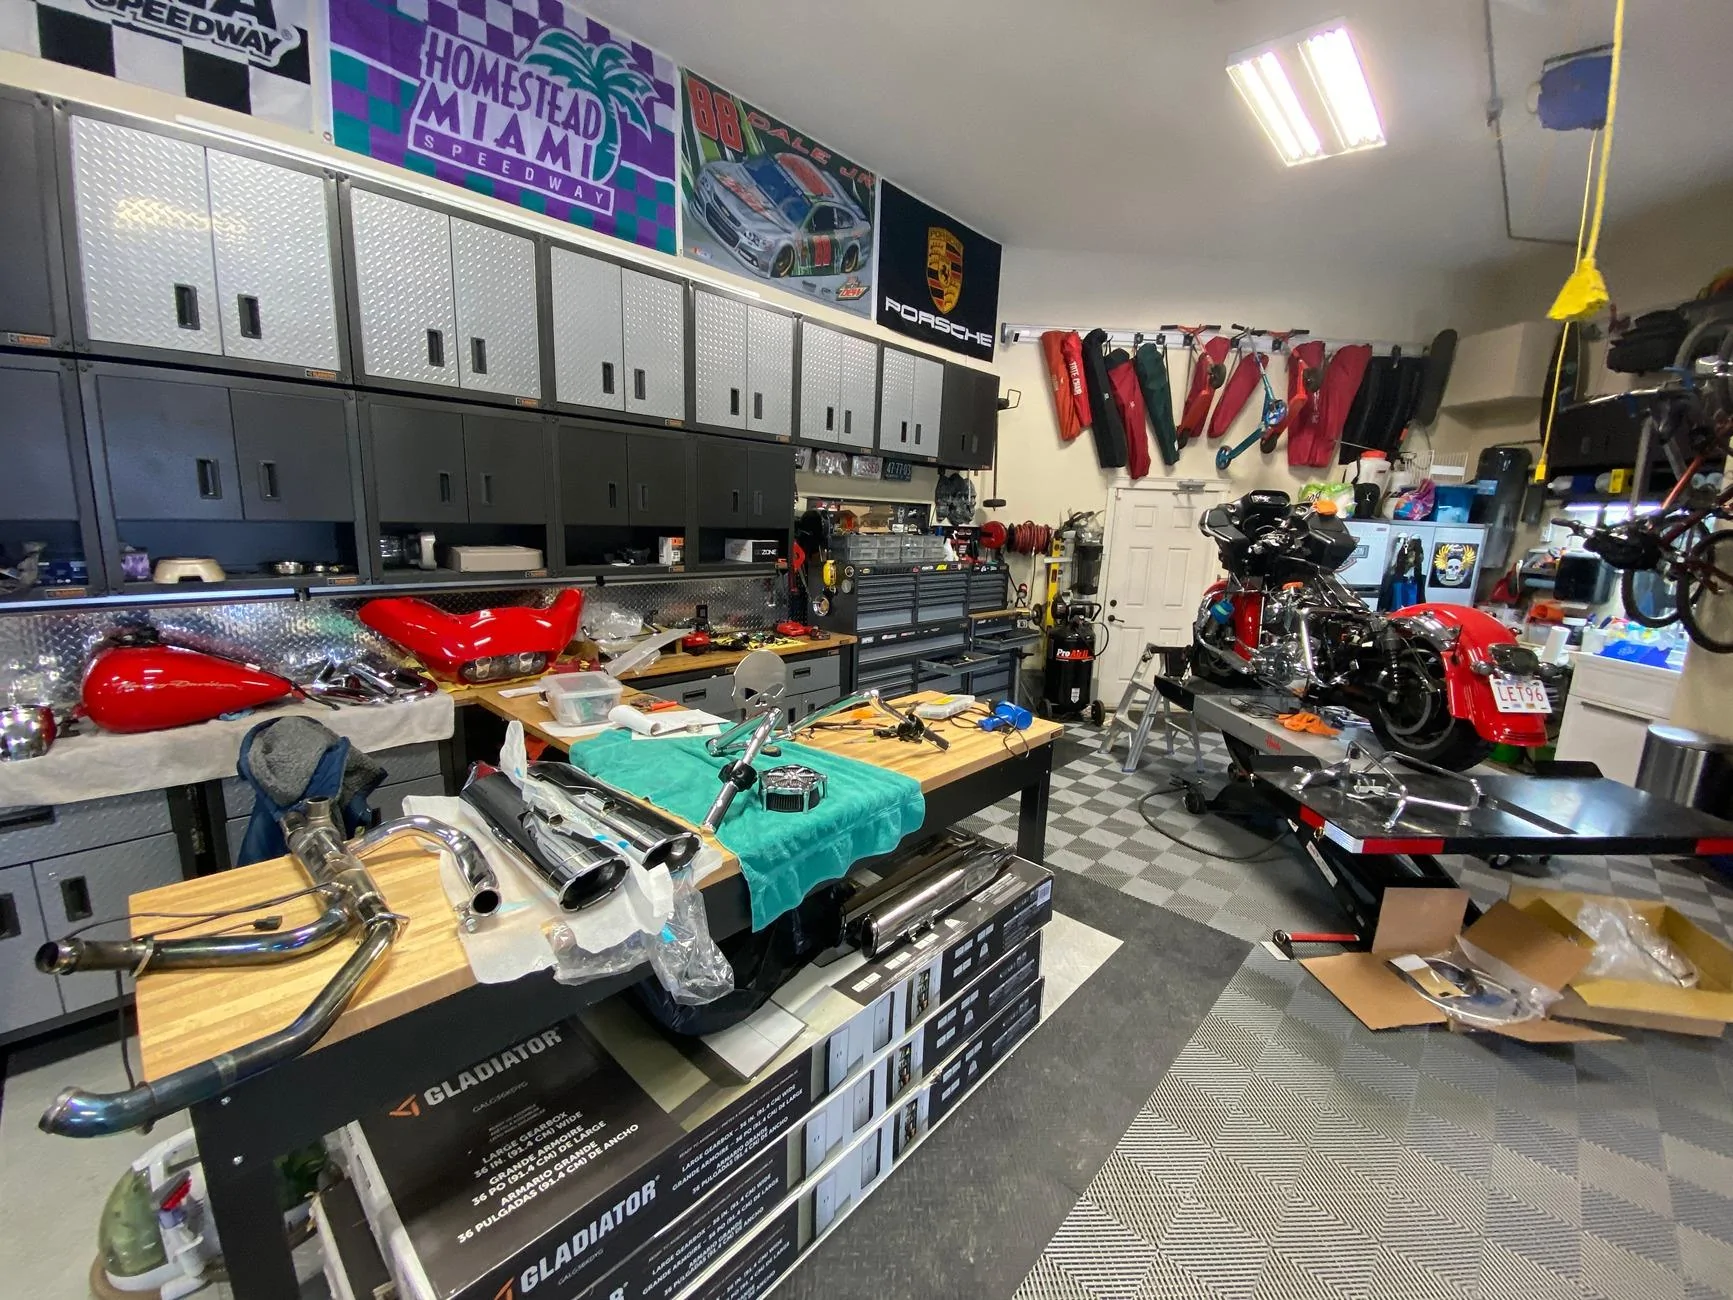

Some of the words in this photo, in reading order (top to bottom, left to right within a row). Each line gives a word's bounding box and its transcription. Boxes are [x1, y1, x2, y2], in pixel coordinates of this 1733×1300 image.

[426, 31, 602, 141] HOMESTEAD
[687, 76, 744, 153] 88
[417, 81, 593, 180] MIAMI
[424, 134, 604, 204] SPEEDWAY
[746, 111, 832, 165] DALE
[839, 165, 876, 188] JR
[885, 296, 992, 347] PORSCHE
[1497, 686, 1544, 702] LET96
[424, 1029, 562, 1106] GLADIATOR
[472, 1193, 488, 1207] 36
[489, 1182, 506, 1196] PO
[507, 1166, 535, 1184] (91.4
[536, 1151, 557, 1167] CM)
[558, 1141, 574, 1154] DE
[573, 1120, 607, 1143] LARGE
[474, 1167, 489, 1179] 36
[490, 1157, 507, 1169] IN.
[507, 1141, 534, 1159] (91.4
[535, 1127, 555, 1143] CM)
[556, 1111, 583, 1131] WIDE
[482, 1139, 519, 1164] LARGE
[519, 1111, 568, 1143] GEARBOX
[489, 1155, 536, 1185] GRANDE
[537, 1125, 584, 1155] ARMOIRE
[672, 1167, 700, 1191] GRANDE
[700, 1146, 729, 1171] ARMOIRE
[778, 1102, 786, 1111] DE
[786, 1088, 803, 1105] LARGE
[681, 1153, 704, 1172] LARGE
[704, 1130, 734, 1155] GEARBOX
[782, 1084, 796, 1097] WIDE
[701, 1160, 734, 1188] PULGADAS
[760, 1132, 769, 1141] DE
[768, 1116, 789, 1135] ANCHO
[715, 1144, 744, 1170] ARMARIO
[744, 1126, 769, 1147] GRANDE
[457, 1229, 474, 1243] 36
[475, 1189, 538, 1233] PULGADAS
[539, 1172, 566, 1192] (91.4
[566, 1156, 588, 1172] CM)
[588, 1147, 603, 1159] DE
[603, 1124, 639, 1149] ANCHO
[501, 1169, 553, 1207] ARMARIO
[554, 1141, 598, 1171] GRANDE
[520, 1179, 657, 1294] GLADIATOR
[642, 1270, 672, 1295] GRANDE
[672, 1243, 702, 1270] ARMOIRE
[761, 1177, 779, 1195] LARGE
[652, 1254, 675, 1275] LARGE
[675, 1228, 706, 1256] GEARBOX
[756, 1173, 772, 1188] WIDE
[673, 1257, 707, 1288] PULGADAS
[743, 1206, 764, 1227] ANCHO
[688, 1239, 718, 1269] ARMARIO
